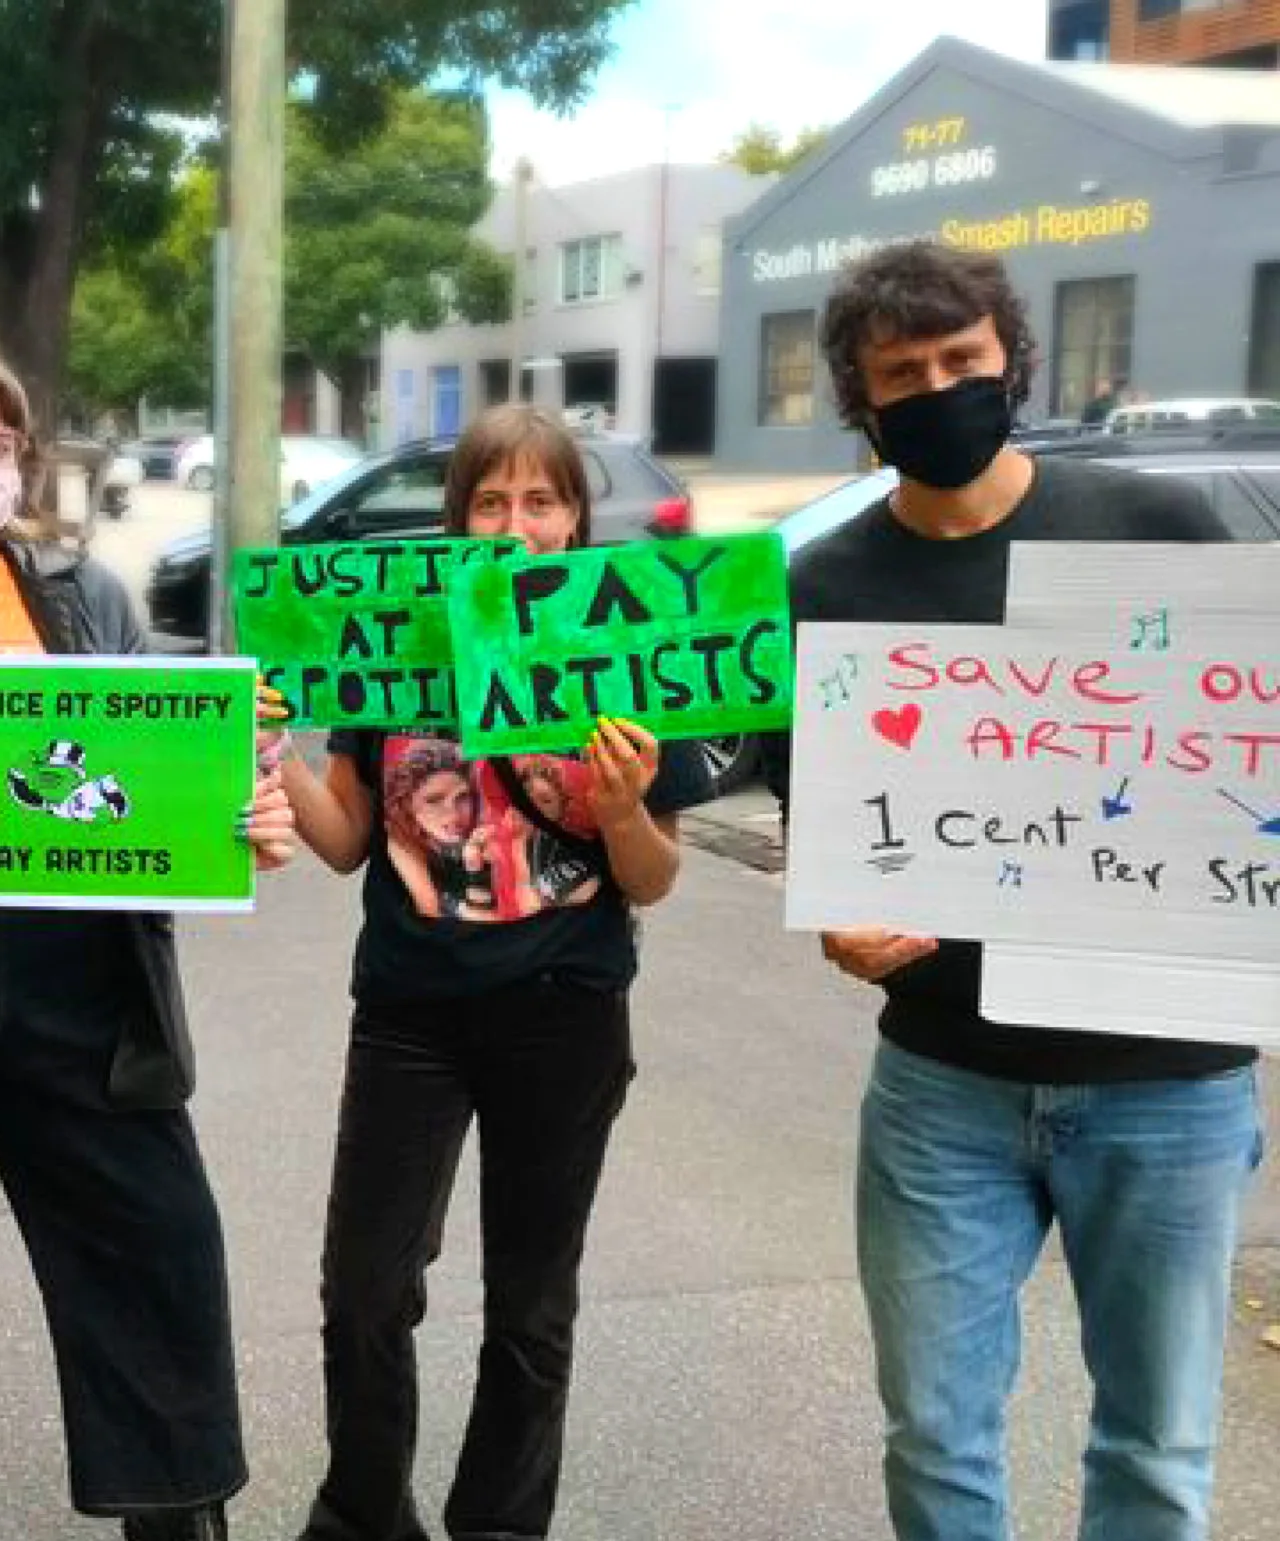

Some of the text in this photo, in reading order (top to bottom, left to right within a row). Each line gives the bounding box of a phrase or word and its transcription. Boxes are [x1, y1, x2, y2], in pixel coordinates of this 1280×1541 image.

[753, 244, 812, 282] South
[942, 212, 1029, 251] Smash
[1037, 199, 1150, 246] Repairs
[246, 545, 517, 599] JUSTI
[511, 545, 725, 636] PAY
[338, 611, 411, 659] AT
[479, 620, 780, 733] ARTISTS
[885, 643, 1150, 705] Save
[57, 692, 93, 719] AT
[106, 692, 232, 719] SPOTIFY
[965, 717, 1280, 777] ARTIST
[45, 848, 172, 875] ARTISTS
[863, 791, 905, 851] 1
[1091, 848, 1167, 892] Per
